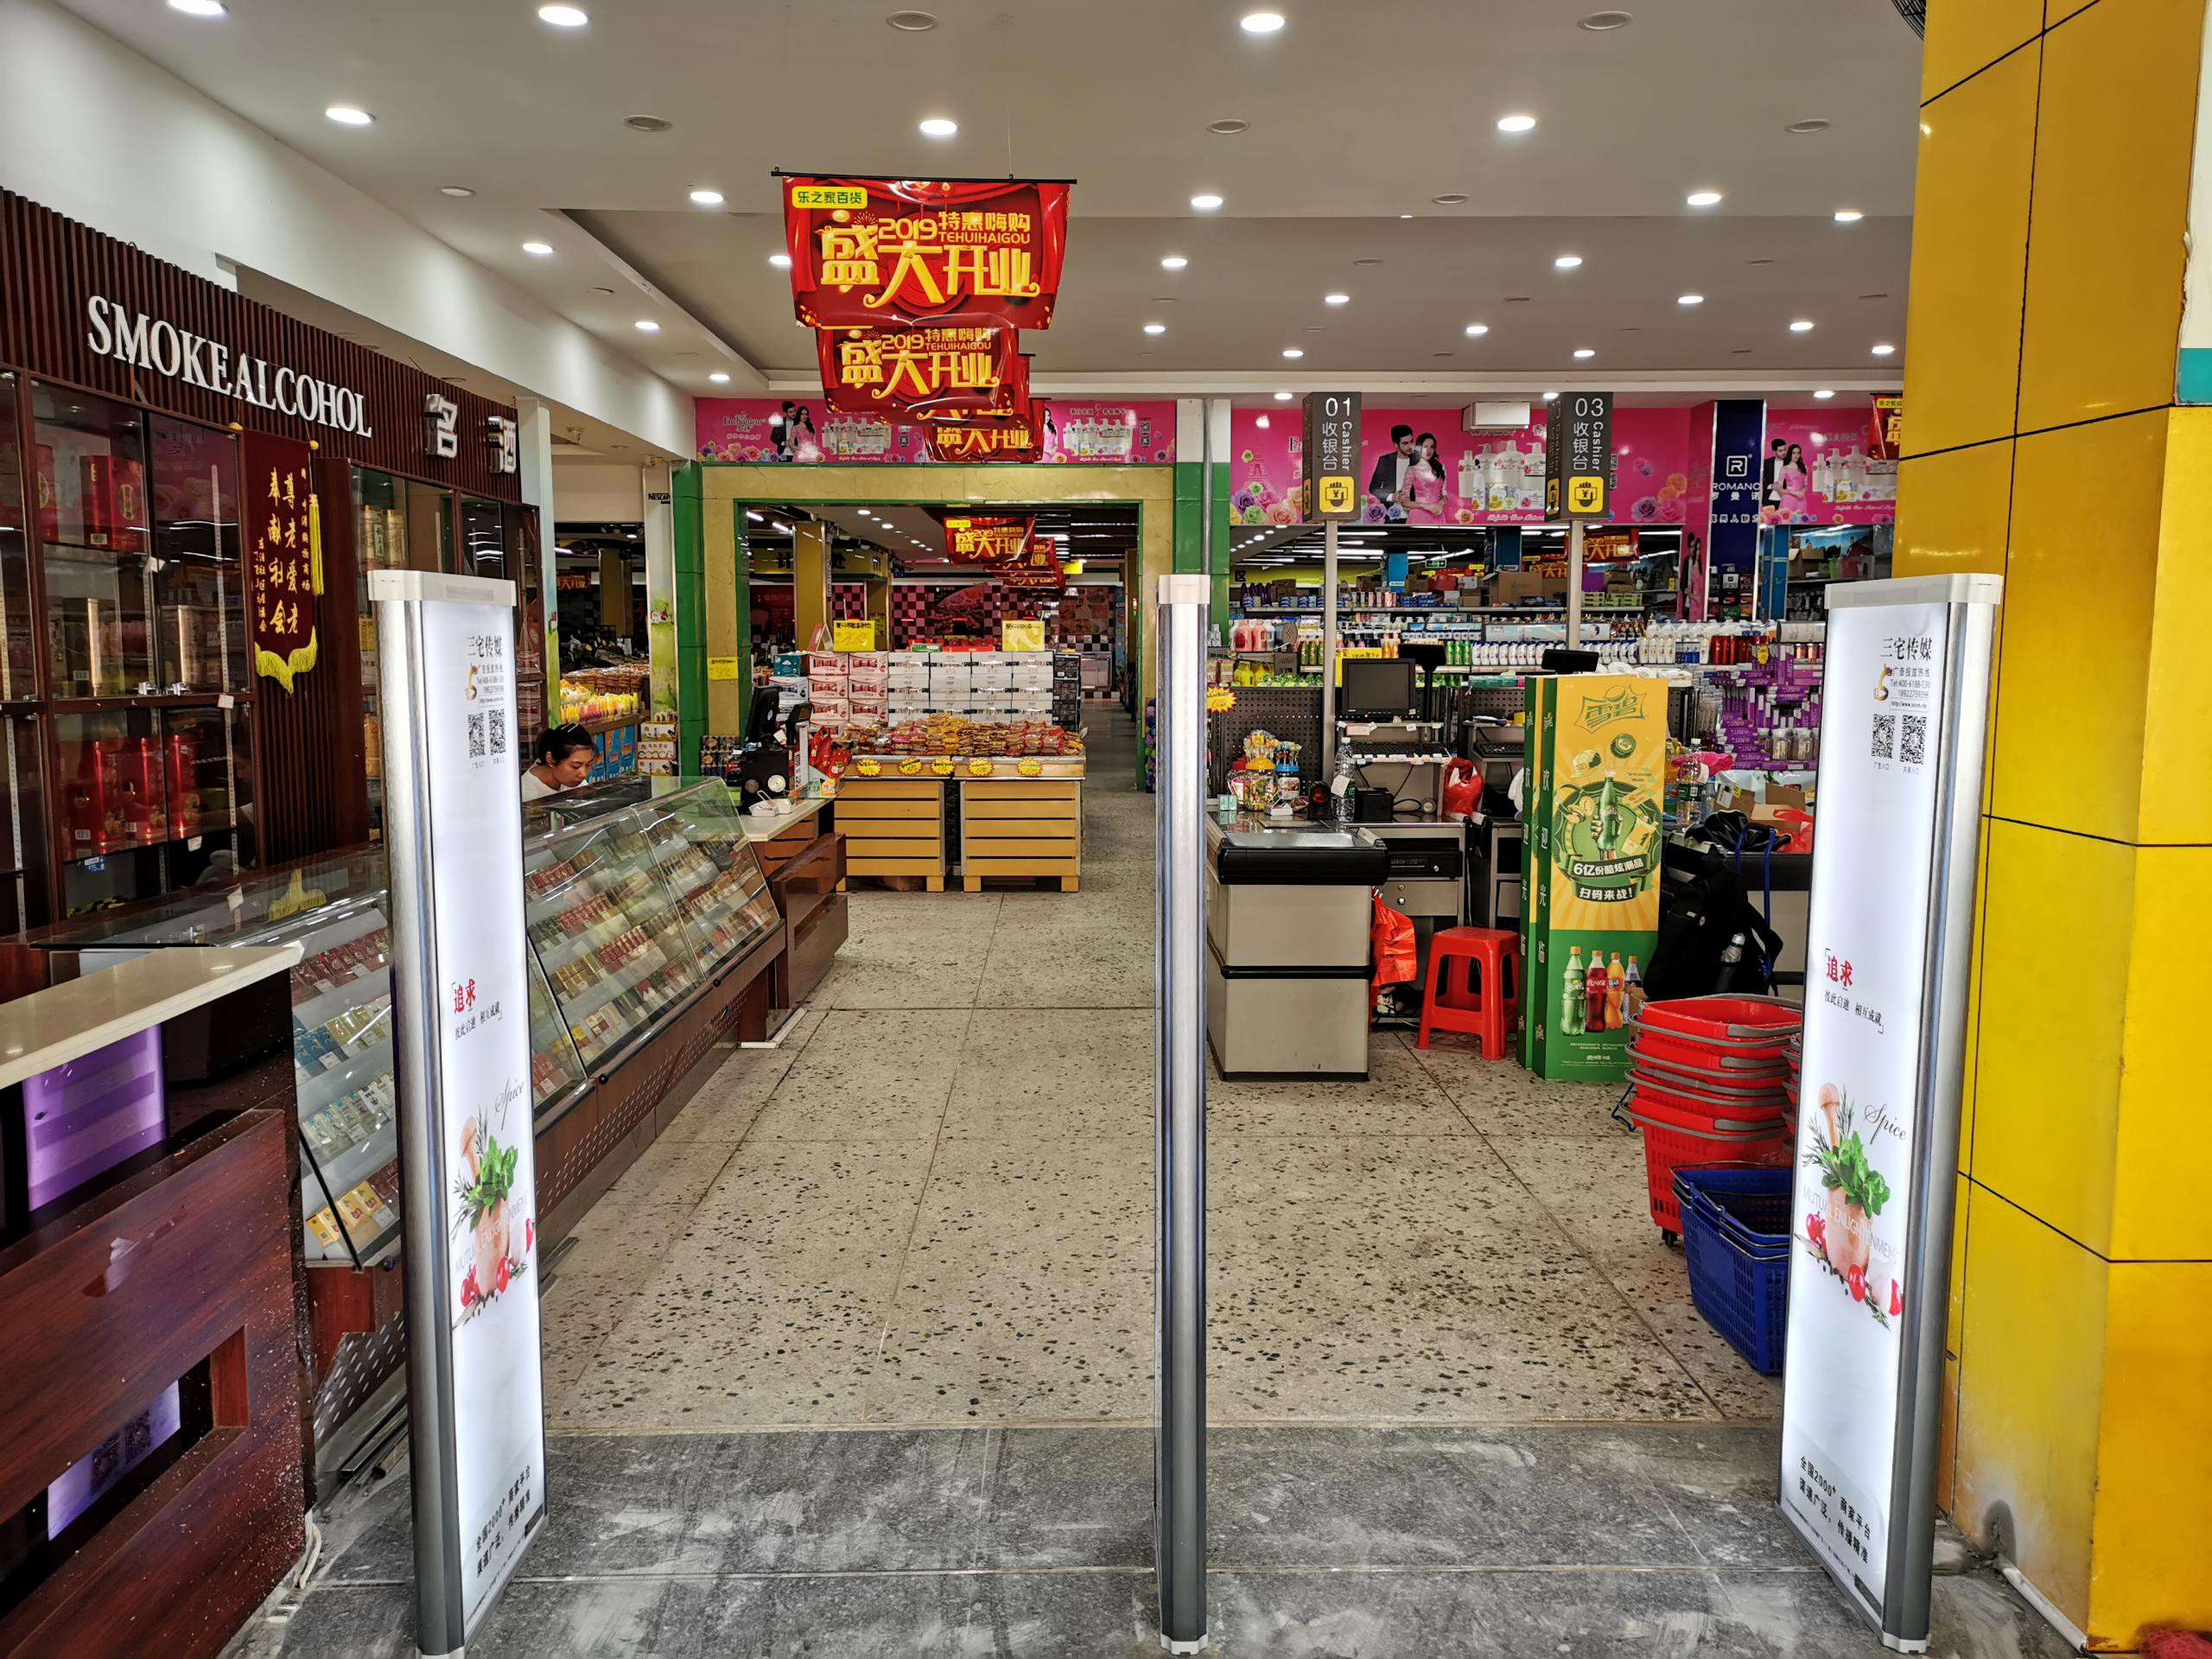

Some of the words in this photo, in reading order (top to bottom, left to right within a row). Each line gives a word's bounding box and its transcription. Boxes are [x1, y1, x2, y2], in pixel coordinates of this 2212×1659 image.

[798, 190, 863, 205] 乐之家百货
[878, 217, 939, 240] 2019
[938, 211, 1031, 232] 特惠嗨购
[938, 231, 1031, 245] TEHUIHAIGOU
[818, 224, 1041, 308] 盛大开业
[880, 334, 925, 351] 2019
[925, 341, 992, 351] TEHUIHAIGOU
[87, 294, 372, 439] SMOKEALCOHOL
[838, 340, 1001, 400] 盛大开业
[1325, 397, 1351, 416] 01
[1574, 397, 1605, 417] 03
[1321, 421, 1338, 471] 收银台
[1341, 421, 1353, 471] Cashier
[1572, 422, 1590, 471] 收银台
[1591, 422, 1605, 471] Cashier
[954, 530, 1028, 560] 盛大开业
[467, 635, 503, 658] 三宅传媒
[1880, 637, 1932, 661] 三宅传媒
[1573, 857, 1644, 876] 6亿份酷炫潮品
[1864, 1103, 1908, 1145] Spice
[1840, 1496, 1871, 1541] 商家平台
